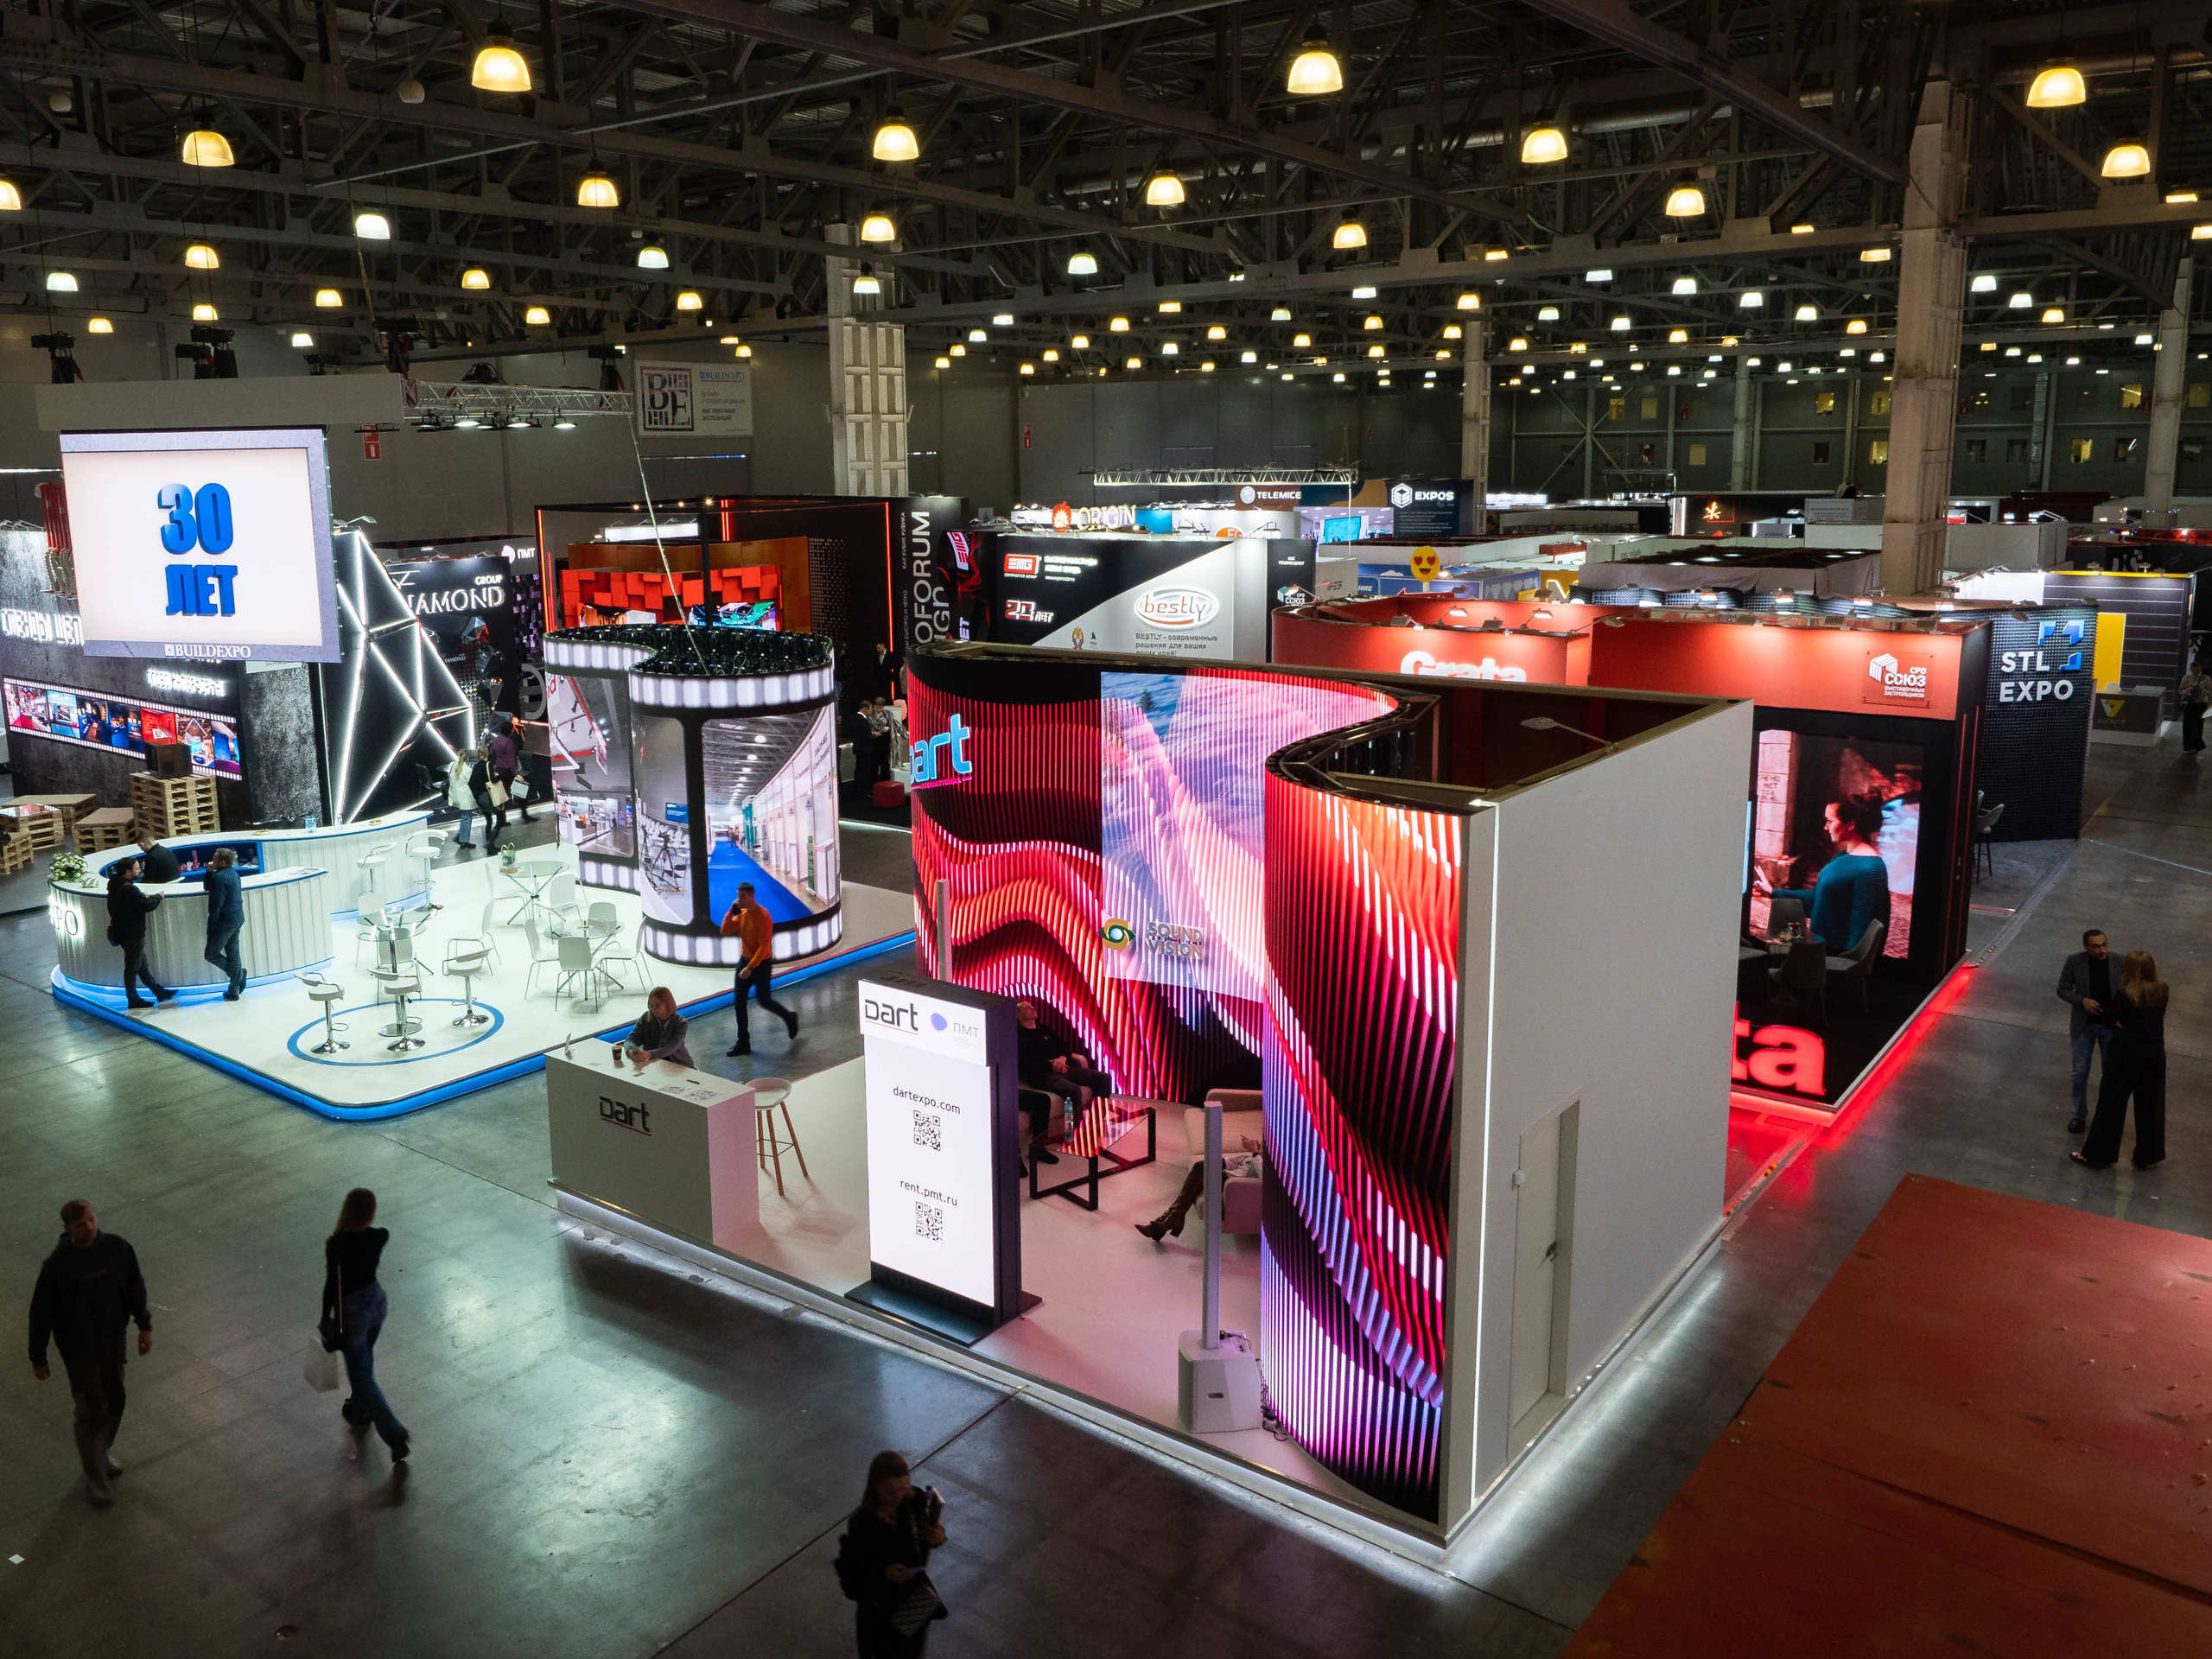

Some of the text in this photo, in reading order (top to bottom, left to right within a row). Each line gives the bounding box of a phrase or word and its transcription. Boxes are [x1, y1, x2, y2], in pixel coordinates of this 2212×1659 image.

[1257, 491, 1302, 499] TELEMICE
[1414, 491, 1455, 501] EXPOS
[157, 482, 233, 555] 30
[1077, 505, 1137, 531] ORIGIN
[517, 548, 536, 559] ПМТ
[165, 564, 238, 617] ЛЕТ
[474, 574, 503, 585] GROUP
[406, 586, 506, 615] IAMOND
[1144, 594, 1207, 621] bestly
[175, 644, 251, 659] BUILDEXPO
[2000, 651, 2050, 673] STL
[1885, 673, 1927, 687] СОЮЗ
[1910, 666, 1928, 675] СРО
[1999, 679, 2074, 702] EXPO
[1147, 921, 1203, 944] SOUND
[1145, 938, 1203, 960] VISION
[864, 999, 918, 1032] Dart
[953, 1022, 979, 1038] ПМТ
[893, 1086, 961, 1115] dartexpo.com
[599, 1096, 651, 1133] Dart
[899, 1180, 958, 1206] rent.pmt.ru
